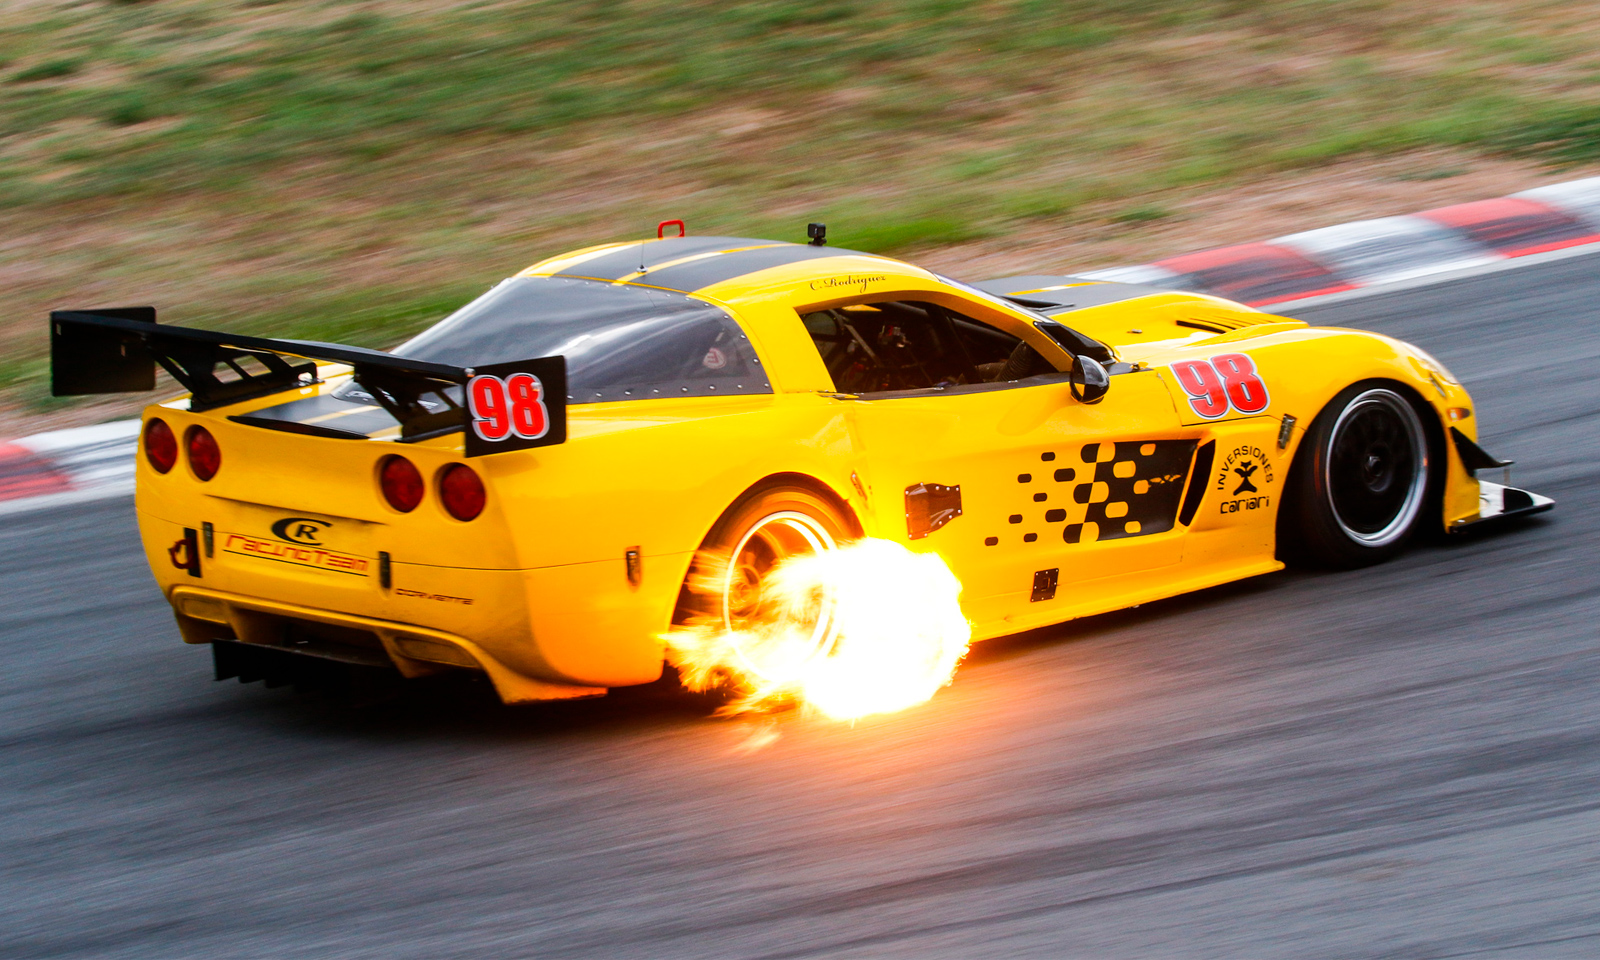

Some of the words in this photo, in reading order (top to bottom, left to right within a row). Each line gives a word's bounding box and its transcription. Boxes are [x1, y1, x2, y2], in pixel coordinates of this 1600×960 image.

[466, 372, 550, 442] 98
[1170, 353, 1270, 420] 98
[1217, 445, 1273, 490] INVERSIONES
[395, 588, 474, 605] CORVETTE
